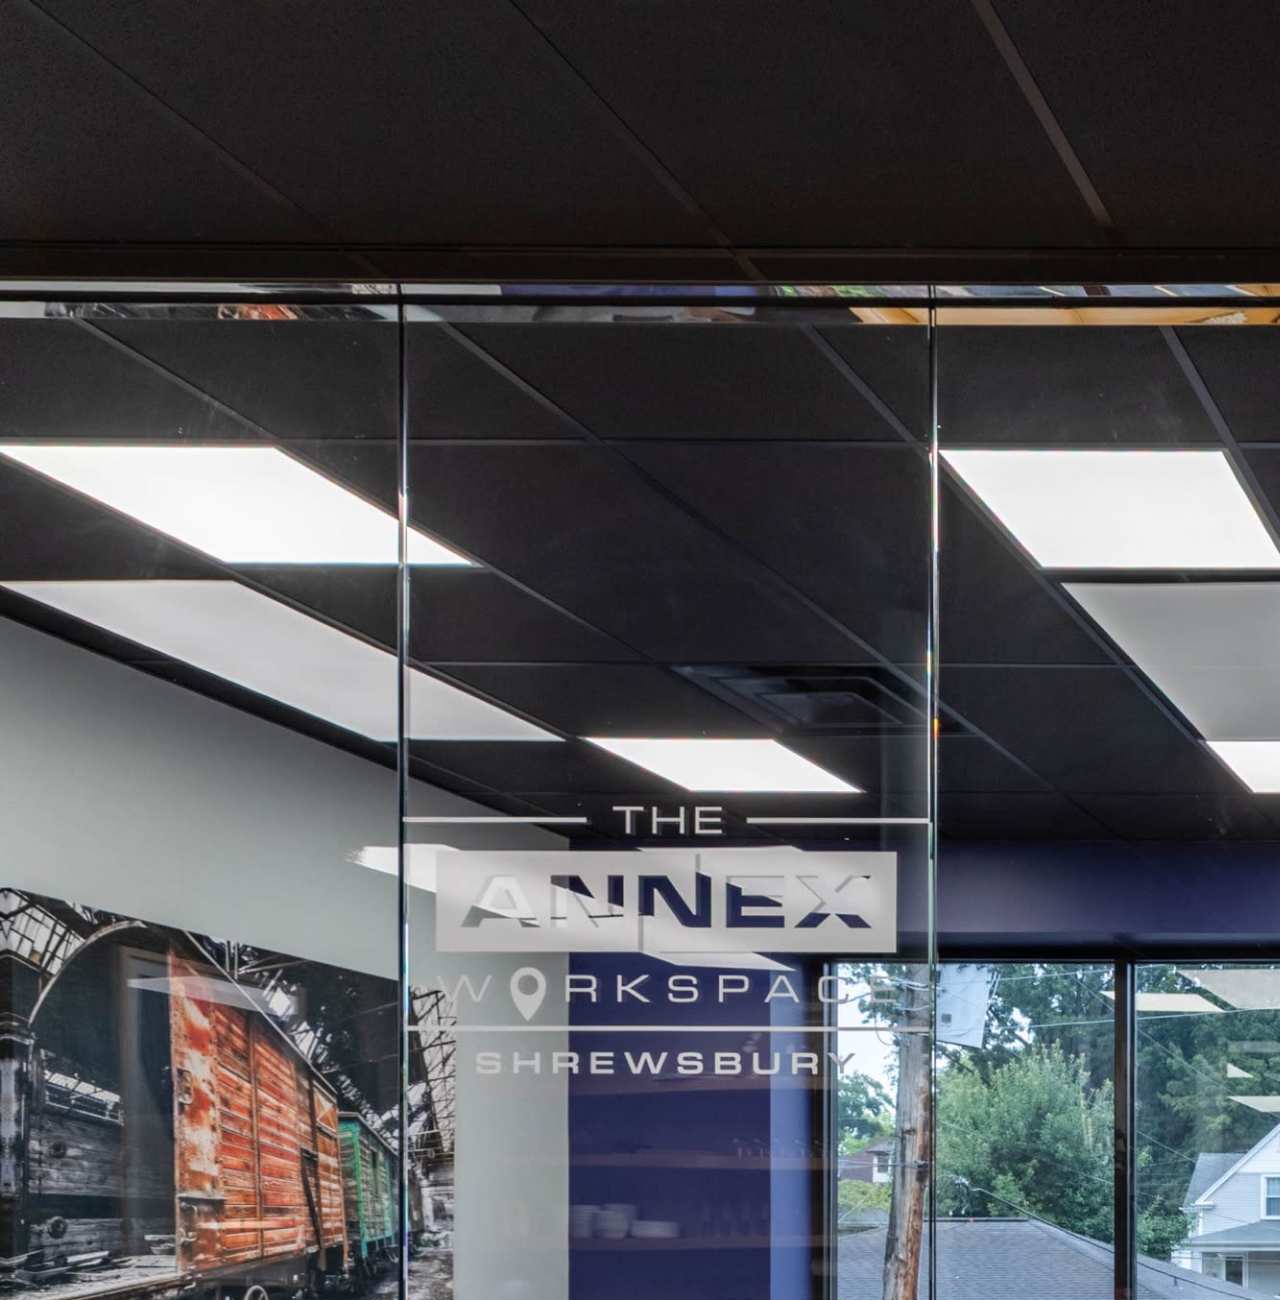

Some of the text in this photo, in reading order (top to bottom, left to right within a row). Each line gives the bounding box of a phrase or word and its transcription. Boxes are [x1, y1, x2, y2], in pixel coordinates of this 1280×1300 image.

[612, 806, 723, 835] THE
[459, 874, 872, 929] ANNEX
[476, 1052, 855, 1075] SHREWSBURY
